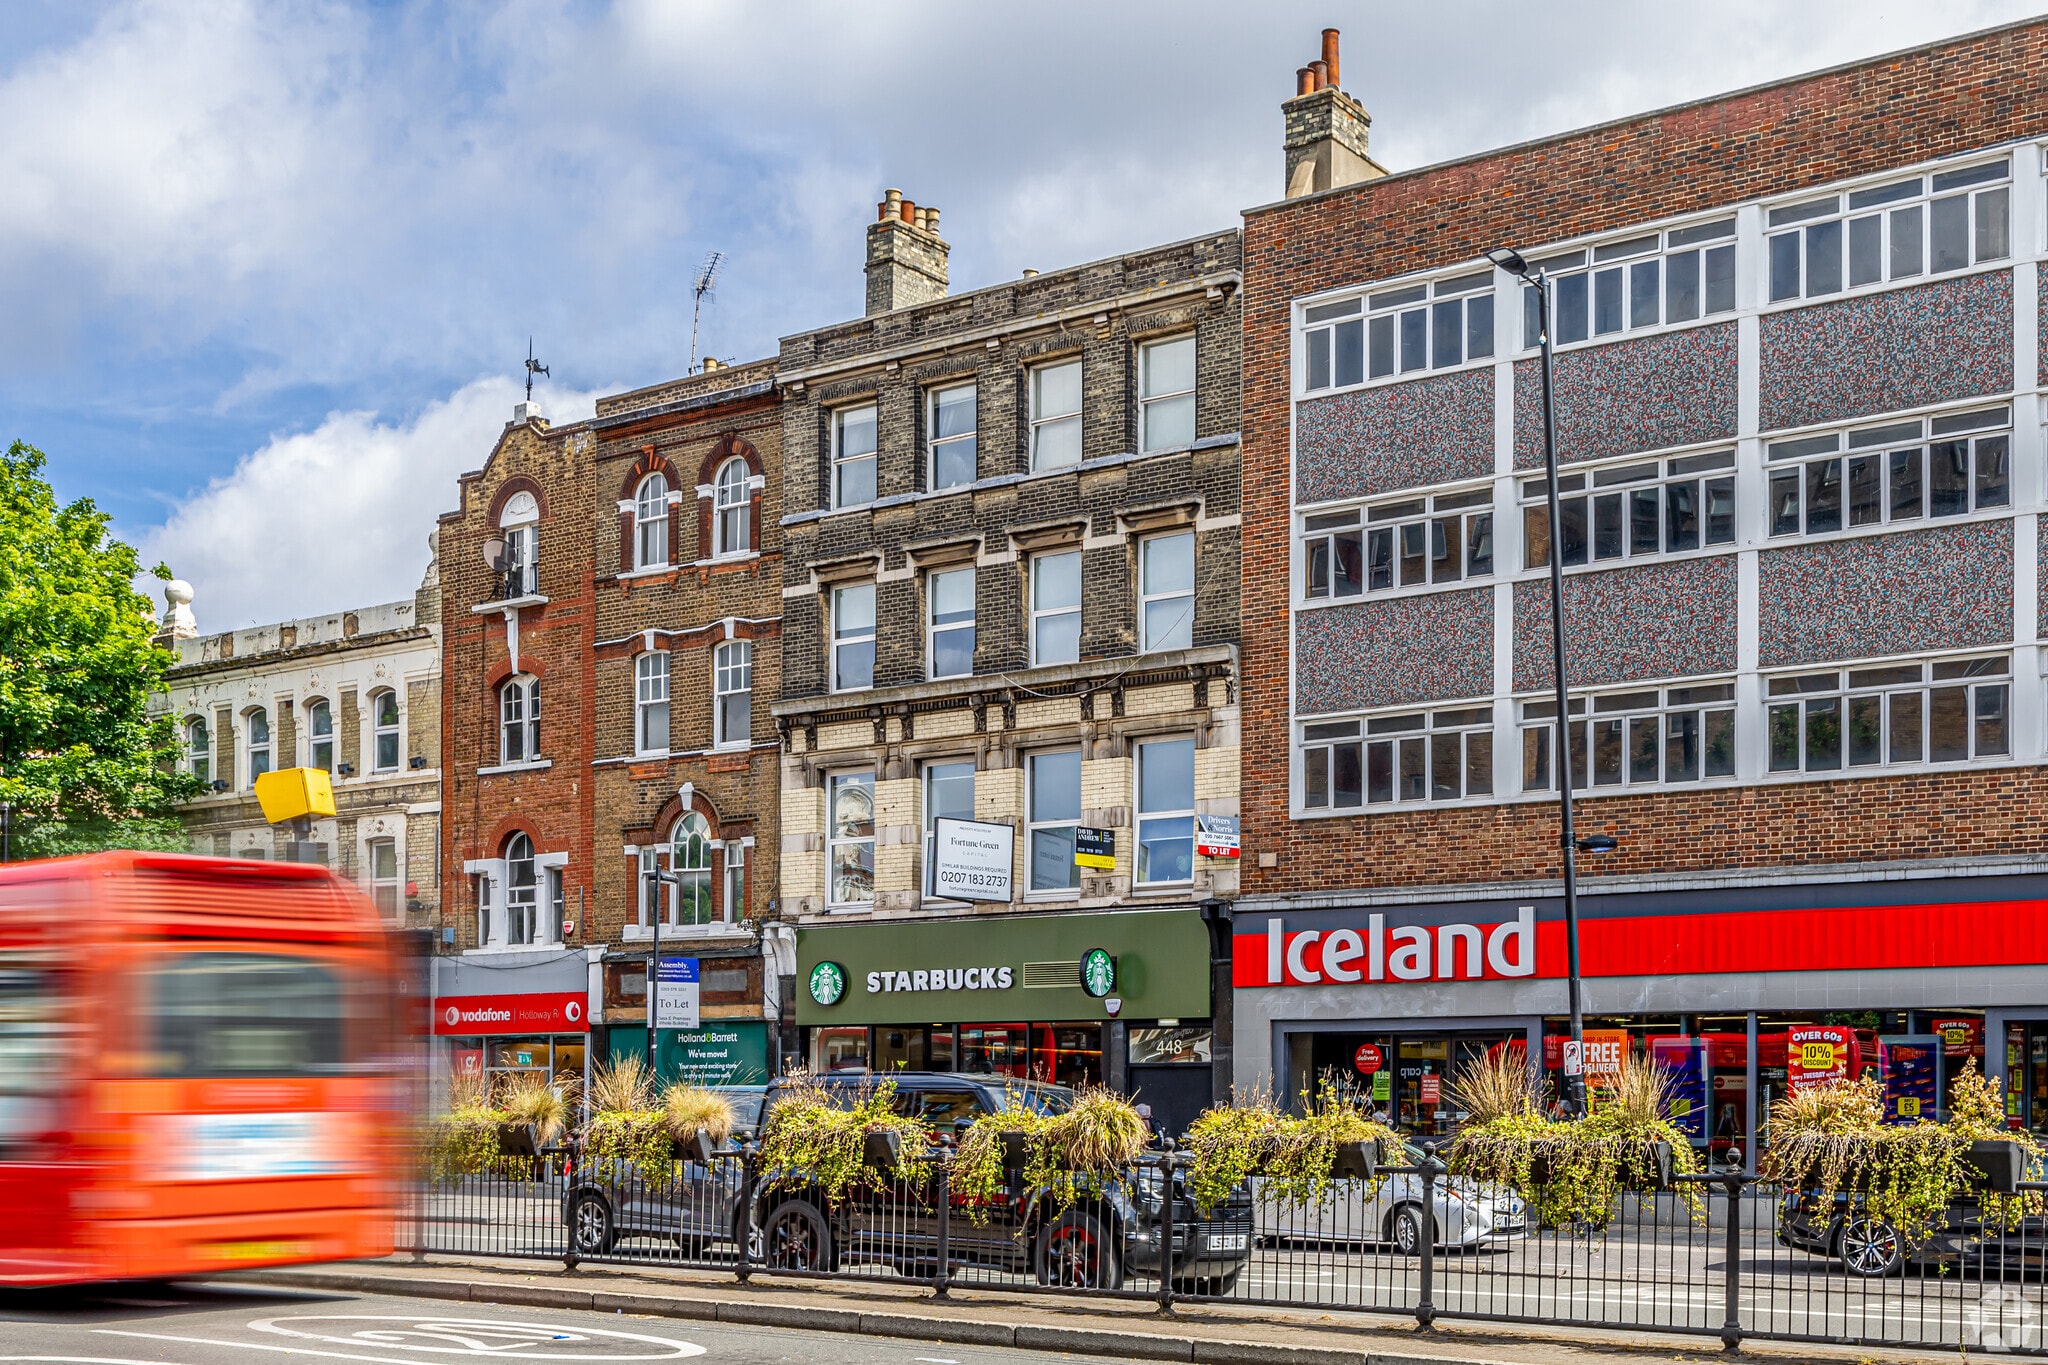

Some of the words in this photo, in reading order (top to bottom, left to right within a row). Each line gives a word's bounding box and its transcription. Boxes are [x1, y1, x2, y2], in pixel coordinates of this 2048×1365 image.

[1208, 816, 1230, 825] Drivers
[951, 837, 979, 848] Fortune
[980, 840, 999, 850] Green
[1208, 846, 1218, 854] TO
[960, 864, 984, 872] BUILDINGS
[985, 866, 1007, 874] REQUIRED
[941, 871, 966, 884] 0207
[968, 874, 984, 885] 183
[986, 875, 1008, 887] 2737
[1268, 906, 1536, 983] Iceland
[658, 961, 689, 970] Assembly.
[867, 966, 1013, 993] STARBUCKS
[659, 999, 671, 1008] To
[674, 999, 689, 1008] Let
[462, 1007, 511, 1022] vodafone
[519, 1010, 551, 1021] Holloway
[1939, 1021, 1957, 1029] OVER
[678, 1033, 706, 1043] Holland
[712, 1032, 738, 1042] Barrett
[1792, 1031, 1821, 1041] OVER
[1823, 1031, 1842, 1042] 60s
[1946, 1031, 1963, 1039] 10%
[1156, 1039, 1183, 1054] 448
[688, 1049, 706, 1058] We've
[707, 1049, 728, 1058] moved
[1582, 1043, 1620, 1063] FREE
[1804, 1046, 1831, 1059] 10%
[679, 1062, 690, 1070] Your
[1803, 1071, 1825, 1079] TUESDAY
[1904, 1102, 1914, 1112] £5
[352, 1323, 590, 1351] 20
